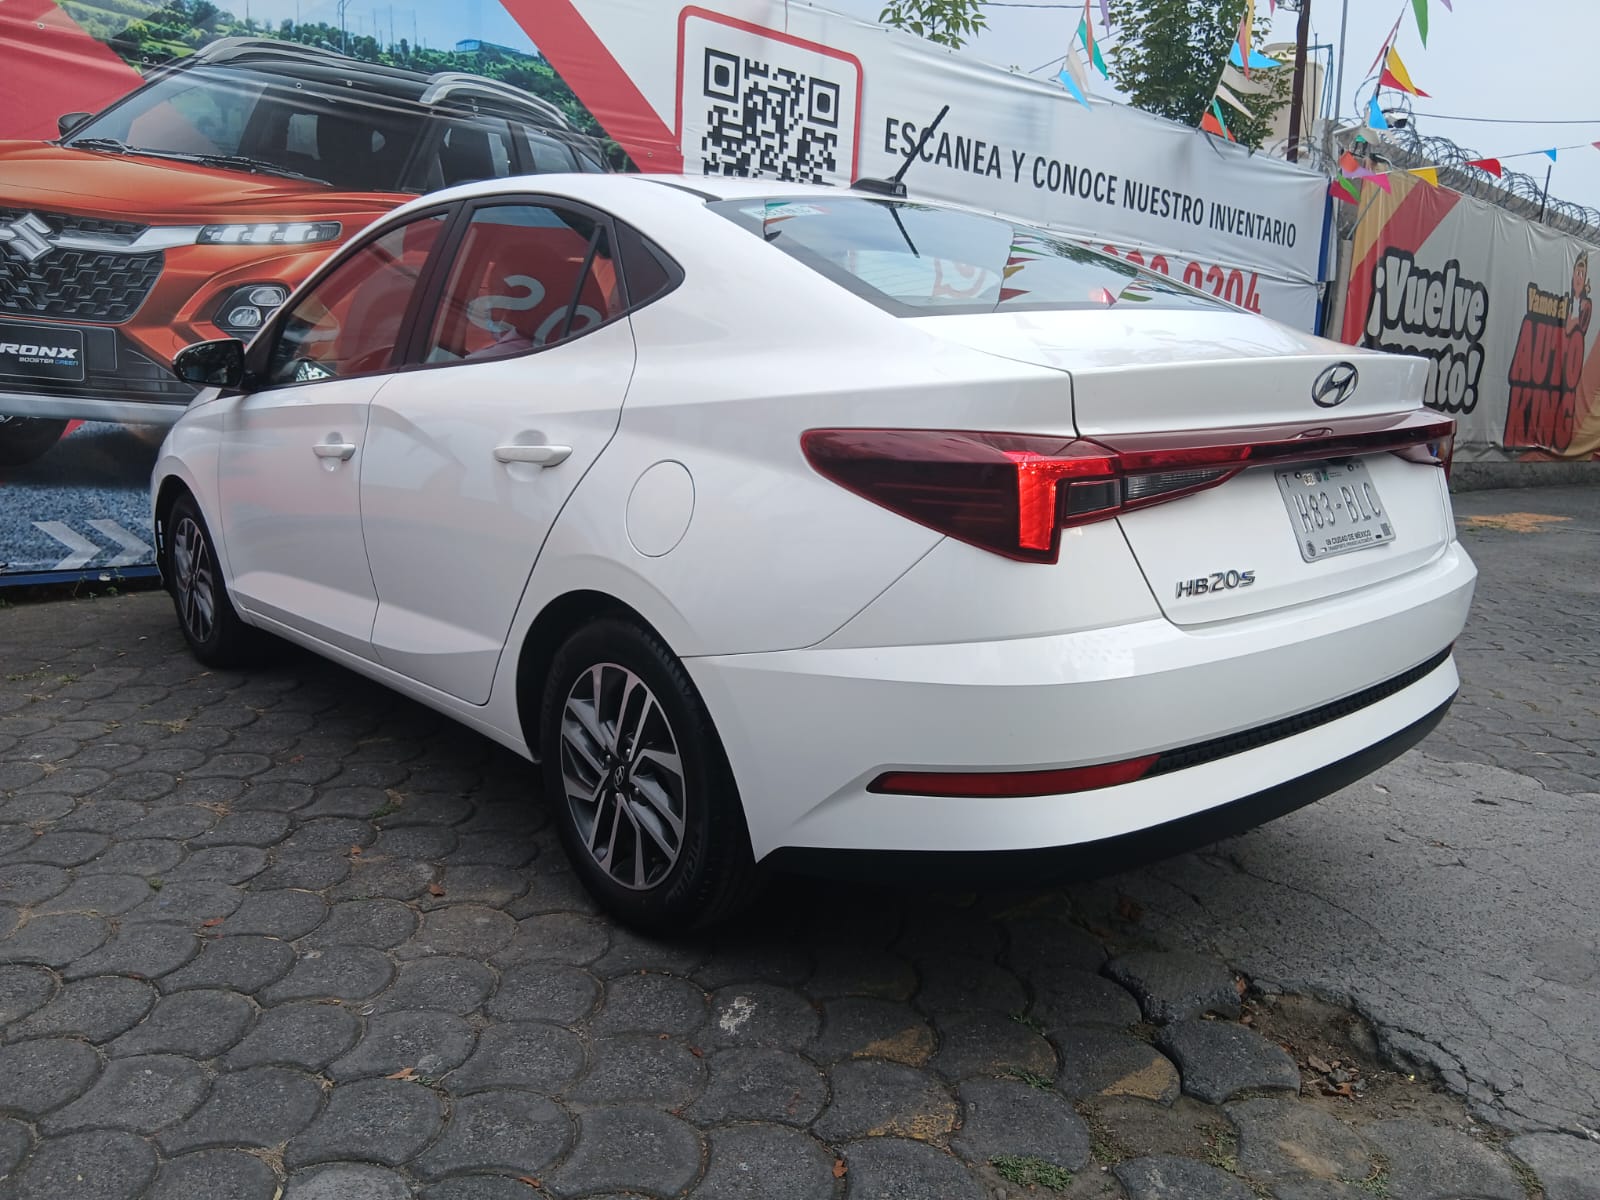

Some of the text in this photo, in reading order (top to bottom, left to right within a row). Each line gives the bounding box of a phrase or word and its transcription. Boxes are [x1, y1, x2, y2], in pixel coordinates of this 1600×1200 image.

[885, 117, 1297, 248] ESCANEA Y CONOCE NUESTRO INVENTARIO
[1366, 251, 1487, 340] ¡Vuelve
[1510, 319, 1585, 389] AUTO
[1503, 386, 1577, 449] KING
[1293, 482, 1381, 533] H83-BLC
